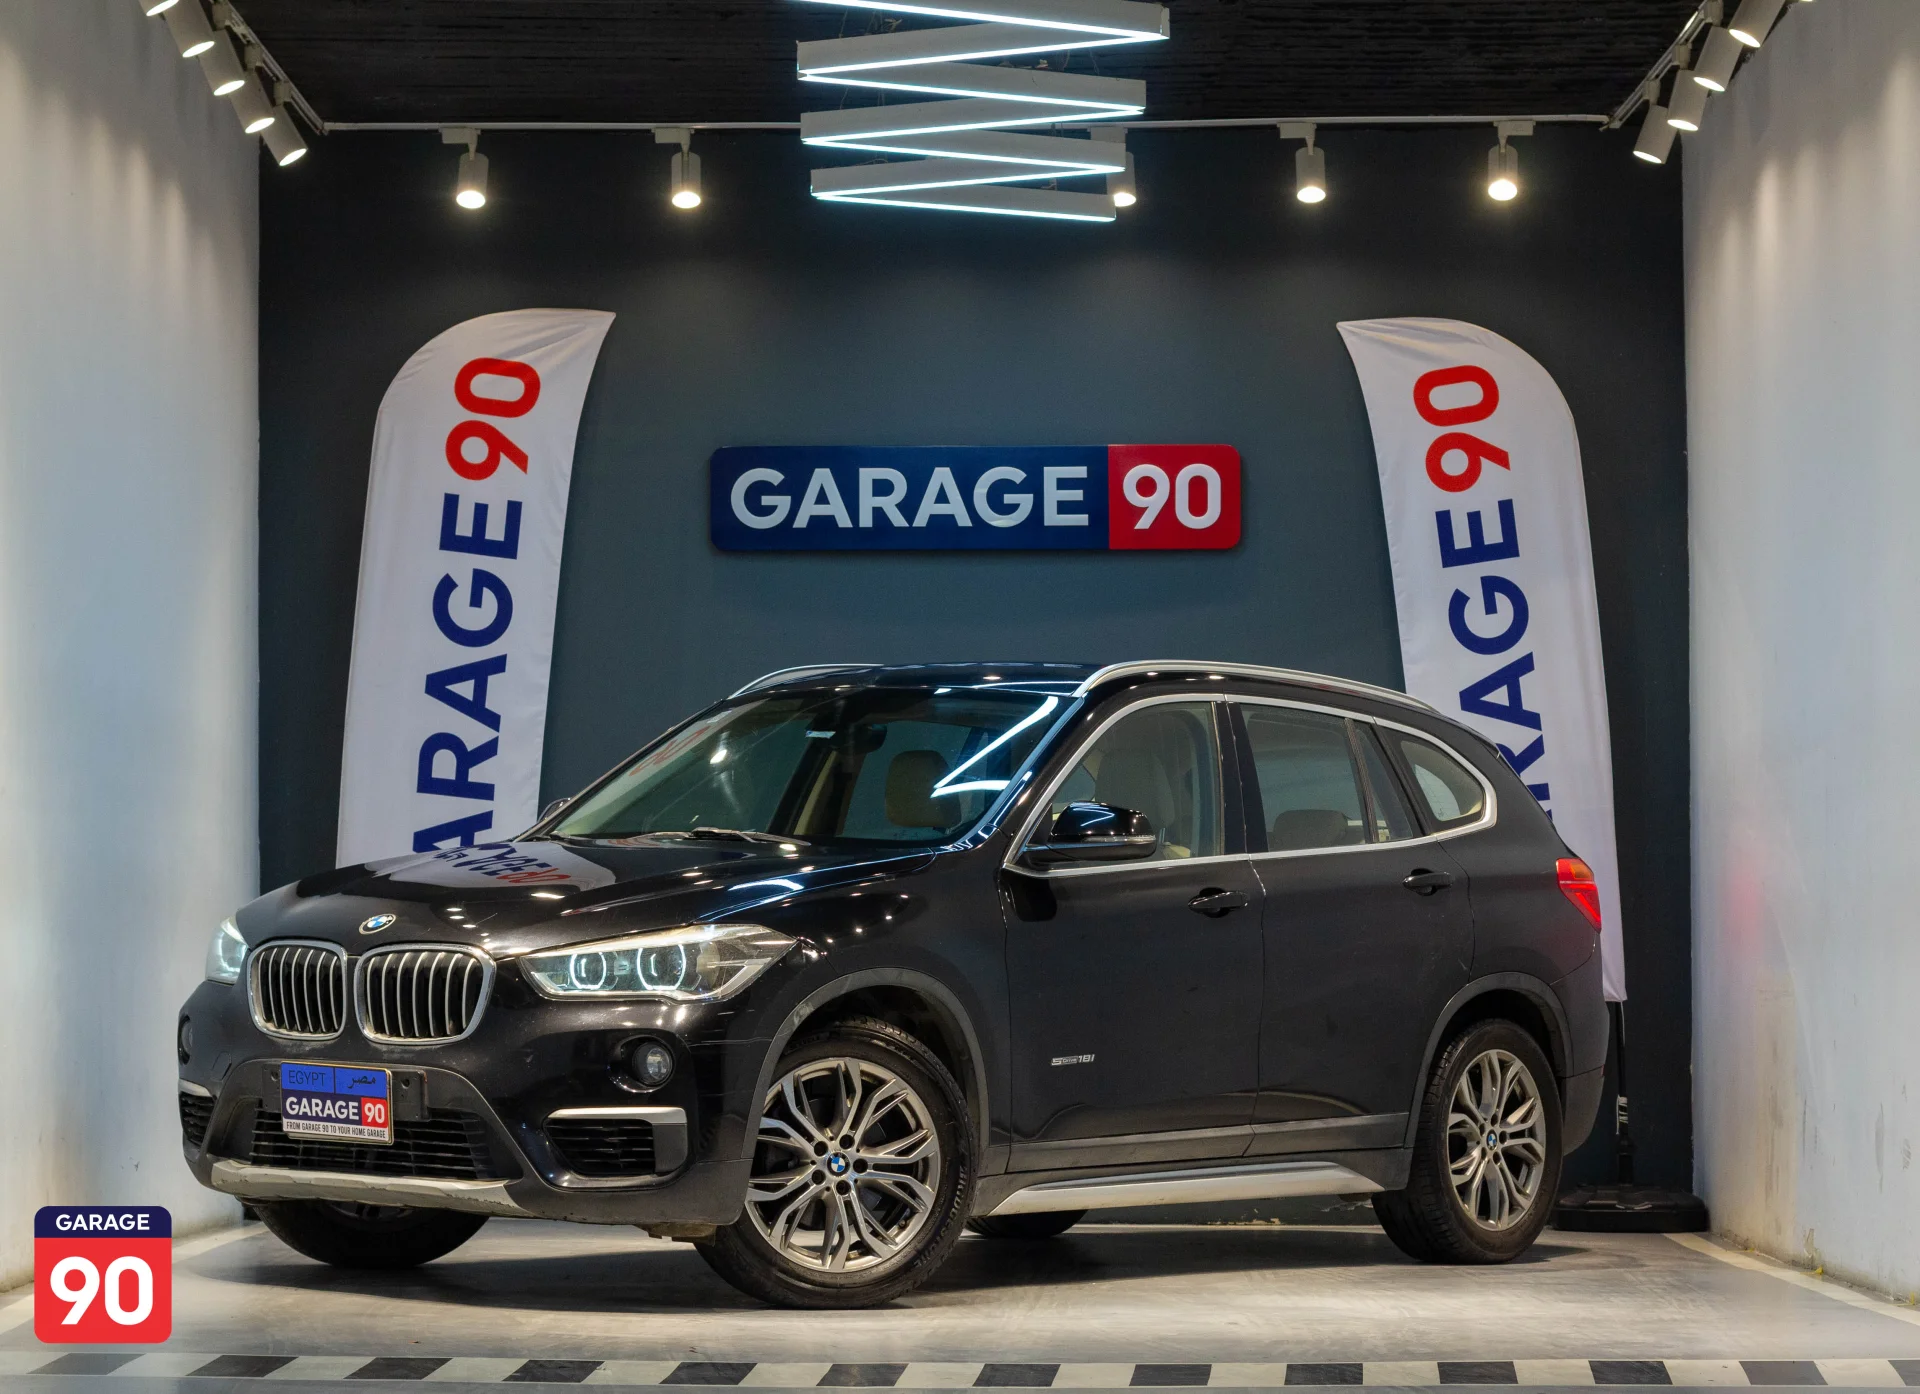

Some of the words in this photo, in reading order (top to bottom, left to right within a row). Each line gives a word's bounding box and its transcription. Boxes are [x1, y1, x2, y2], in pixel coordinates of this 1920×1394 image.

[445, 357, 541, 481] 90
[1413, 365, 1511, 493] 90
[730, 465, 1089, 530] GARAGE
[1122, 463, 1221, 530] 90
[412, 492, 523, 854] ARAGE
[1435, 498, 1553, 822] AGE
[285, 1096, 360, 1120] GARAGE
[364, 1102, 385, 1123] 90
[288, 1070, 326, 1087] EGYPT
[286, 1121, 301, 1130] FROM
[301, 1122, 321, 1131] GARAGE
[322, 1124, 330, 1132] 90
[330, 1124, 337, 1133] TO
[337, 1126, 351, 1135] YOUR
[351, 1127, 366, 1137] HOME
[366, 1129, 386, 1139] GARAGE
